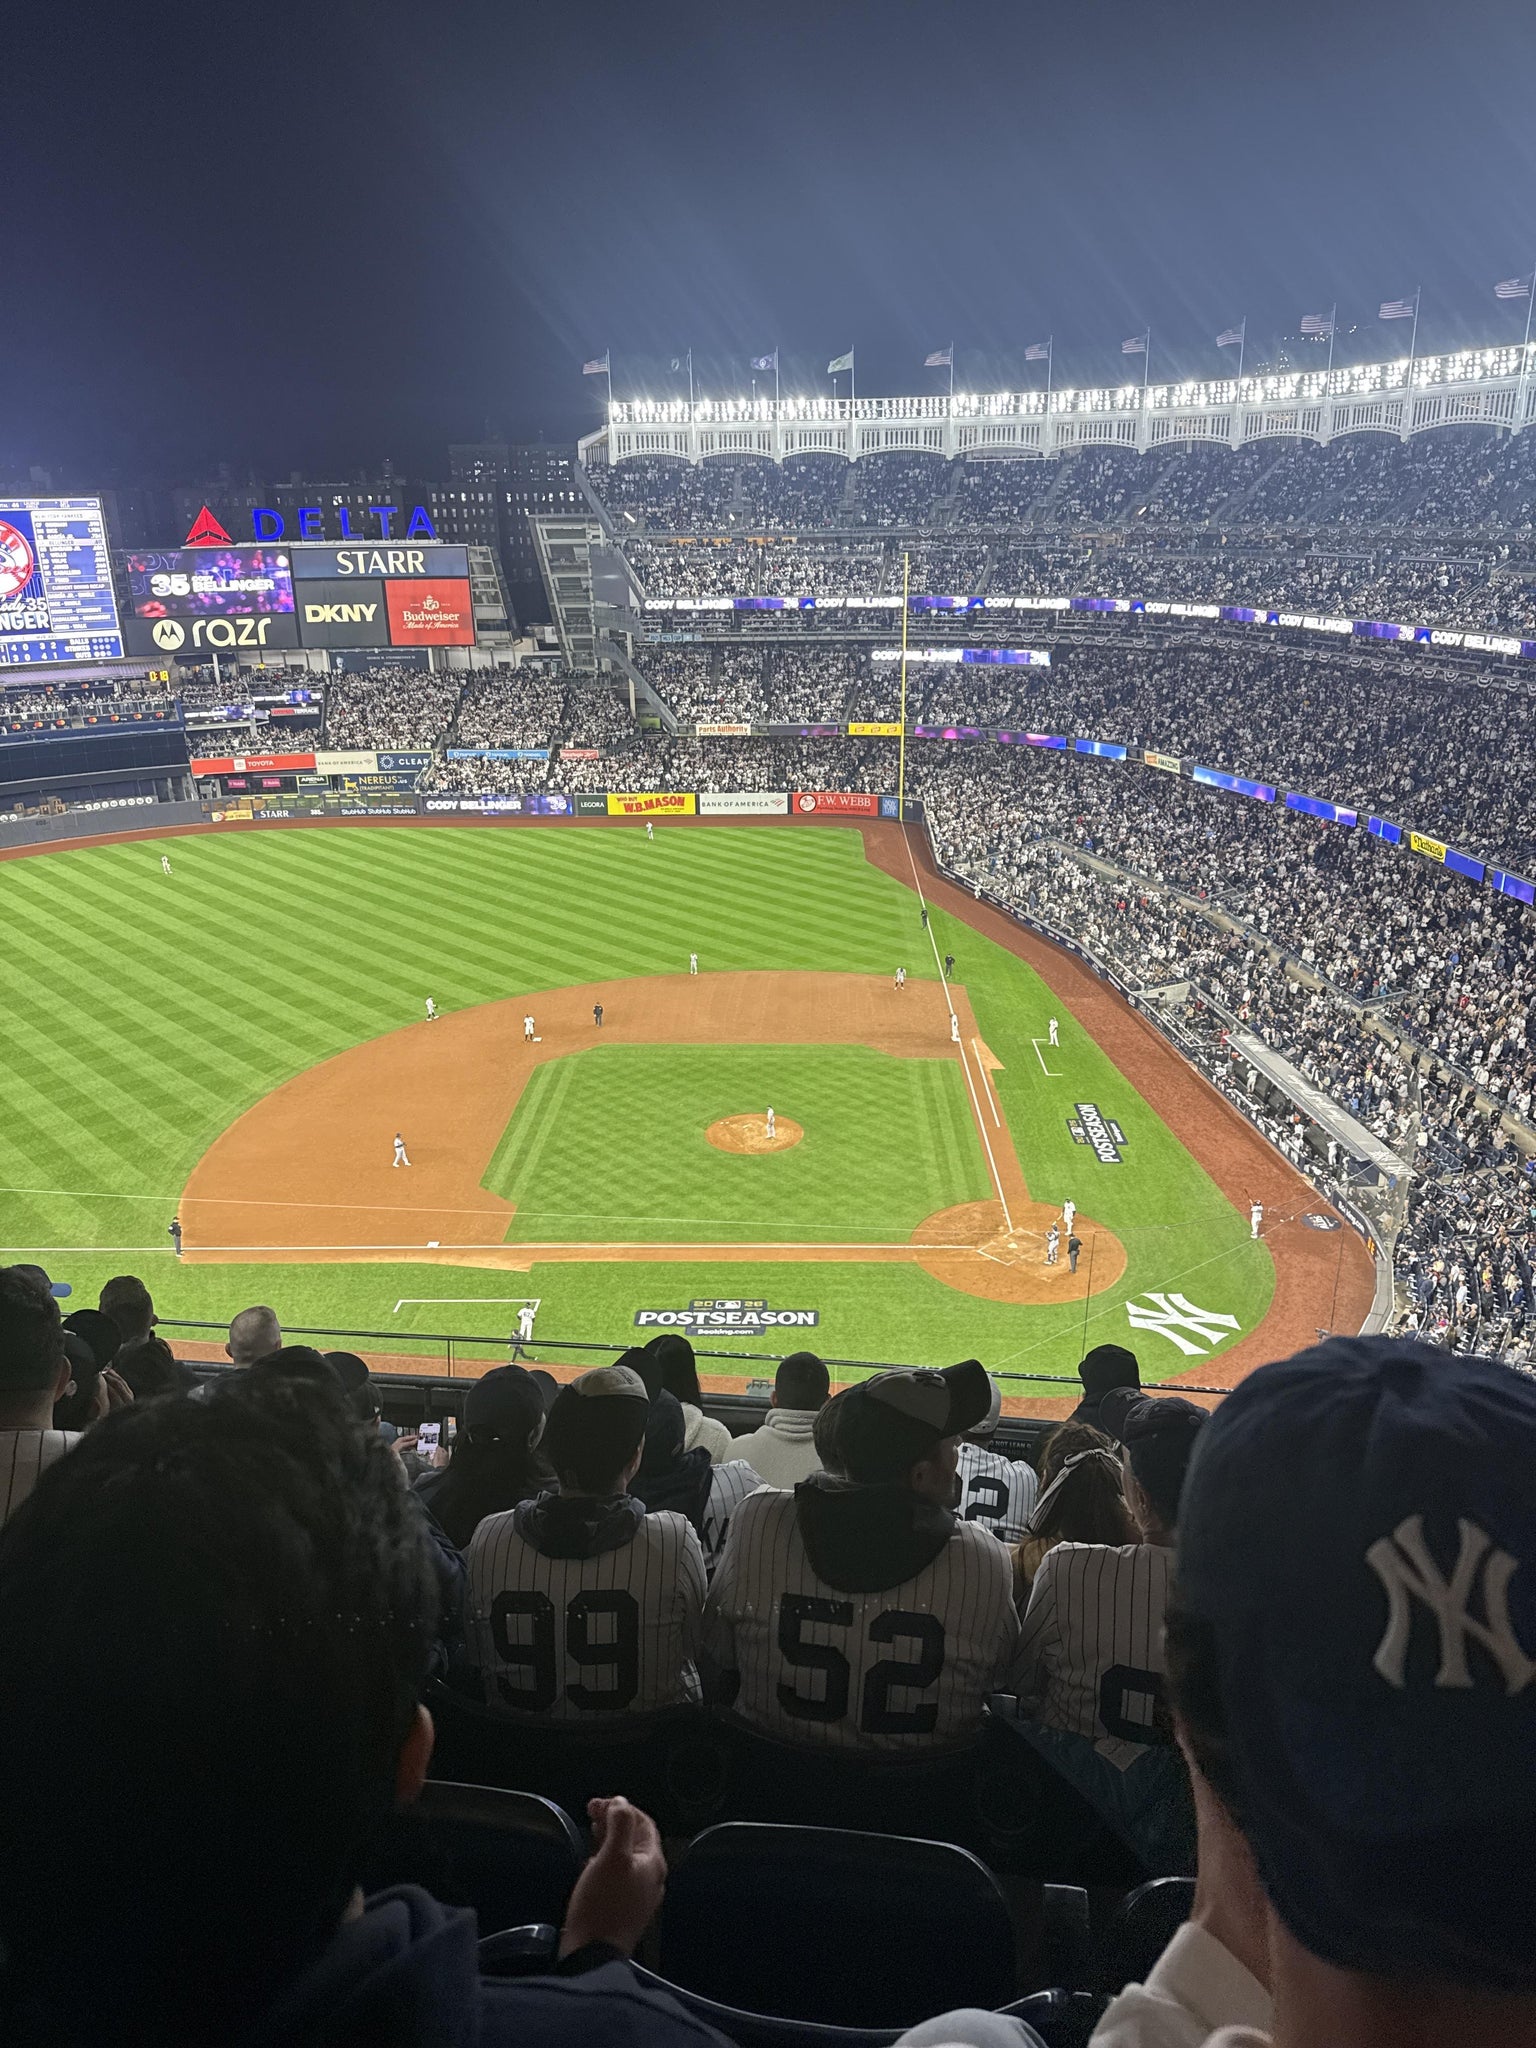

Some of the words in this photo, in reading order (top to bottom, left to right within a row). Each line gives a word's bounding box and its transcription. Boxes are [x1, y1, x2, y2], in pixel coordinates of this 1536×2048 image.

[252, 506, 437, 542] DELTA
[336, 550, 426, 574] STARR
[151, 574, 191, 596] 35
[193, 578, 275, 592] BELLINGER
[25, 598, 48, 612] 35
[304, 603, 377, 623] DKNY
[402, 610, 460, 622] Budweiser
[192, 617, 272, 647] razr
[645, 600, 674, 610] CODY
[676, 598, 734, 610] BELLINGER
[815, 598, 842, 608] CODY
[984, 598, 1013, 608] CODY
[1014, 598, 1070, 610] BELLINGER
[1144, 602, 1171, 614] CODY
[1278, 612, 1303, 628] CODY
[1302, 616, 1354, 634] BELLINGER
[1431, 630, 1464, 646] CODY
[1464, 632, 1522, 655] BELLINGER
[22, 643, 29, 651] 0
[50, 642, 57, 650] 2
[24, 654, 31, 662] 0
[871, 650, 902, 661] CODY
[717, 724, 748, 734] Authority
[247, 760, 275, 768] TOYOTA
[358, 776, 398, 785] NEREUS
[426, 800, 458, 810] CODY
[460, 800, 522, 810] BELLINGER
[817, 795, 837, 806] F.W.
[840, 796, 872, 807] WEBB
[260, 810, 290, 818] STARR
[1414, 834, 1443, 857] Nathan's
[1078, 1104, 1120, 1162] POSTSEASON
[638, 1311, 816, 1325] POSTSEASON
[1365, 1513, 1536, 1696] NY
[489, 1590, 640, 1711] 99
[776, 1591, 946, 1735] 52
